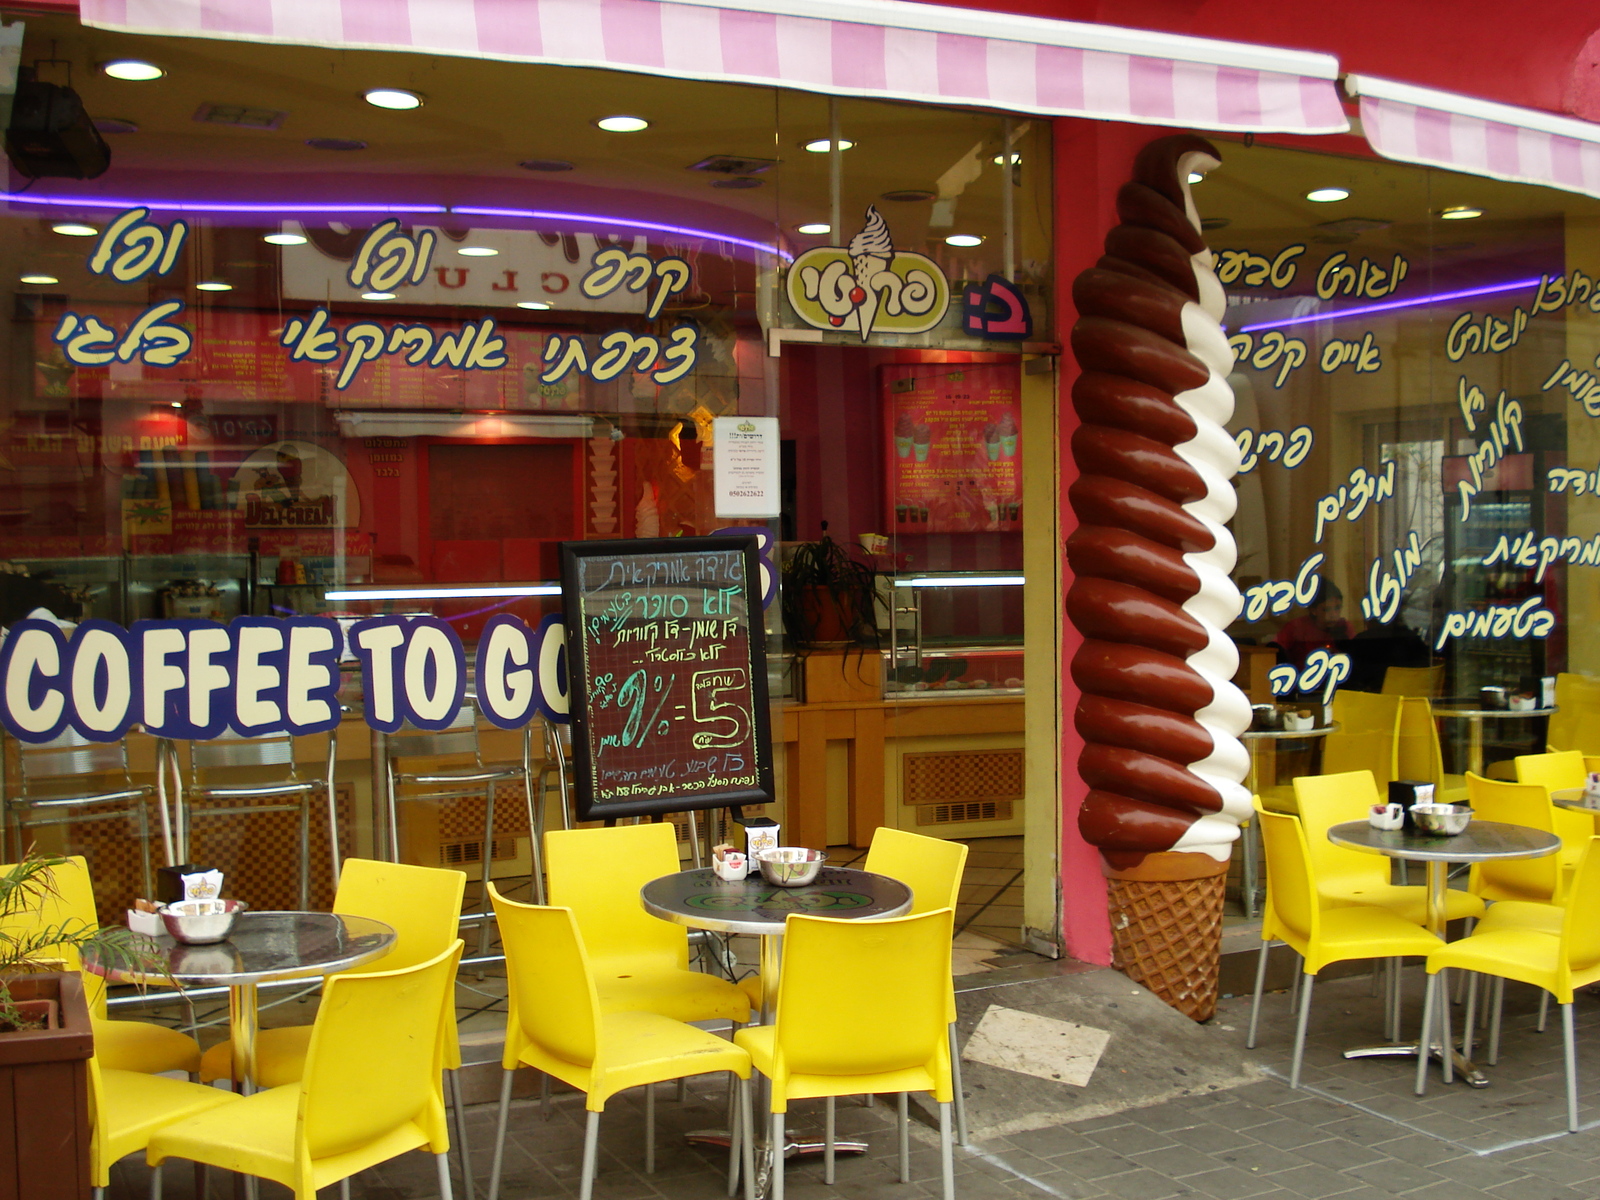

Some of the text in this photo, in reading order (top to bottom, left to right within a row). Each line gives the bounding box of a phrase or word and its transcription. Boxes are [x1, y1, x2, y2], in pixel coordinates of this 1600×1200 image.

[88, 207, 189, 282] ופל
[347, 218, 436, 293] ופל
[580, 246, 691, 321] קרפ
[1316, 253, 1409, 300] יוגורט
[53, 299, 192, 367] בלגי
[281, 306, 508, 390] אמריקאי
[540, 324, 698, 385] צרפתי
[1320, 331, 1382, 374] אייס
[1447, 306, 1529, 361] יוגורט
[1315, 460, 1395, 543] מיצים
[1546, 466, 1600, 497] ודה
[695, 553, 742, 582] גלידה
[635, 585, 742, 619] ללא סוכר
[723, 617, 740, 640] דל
[1435, 595, 1556, 651] בטעמים
[4, 624, 336, 735] COFFEE
[357, 622, 460, 725] TO
[1268, 650, 1350, 706] קפה
[723, 753, 744, 772] כל
